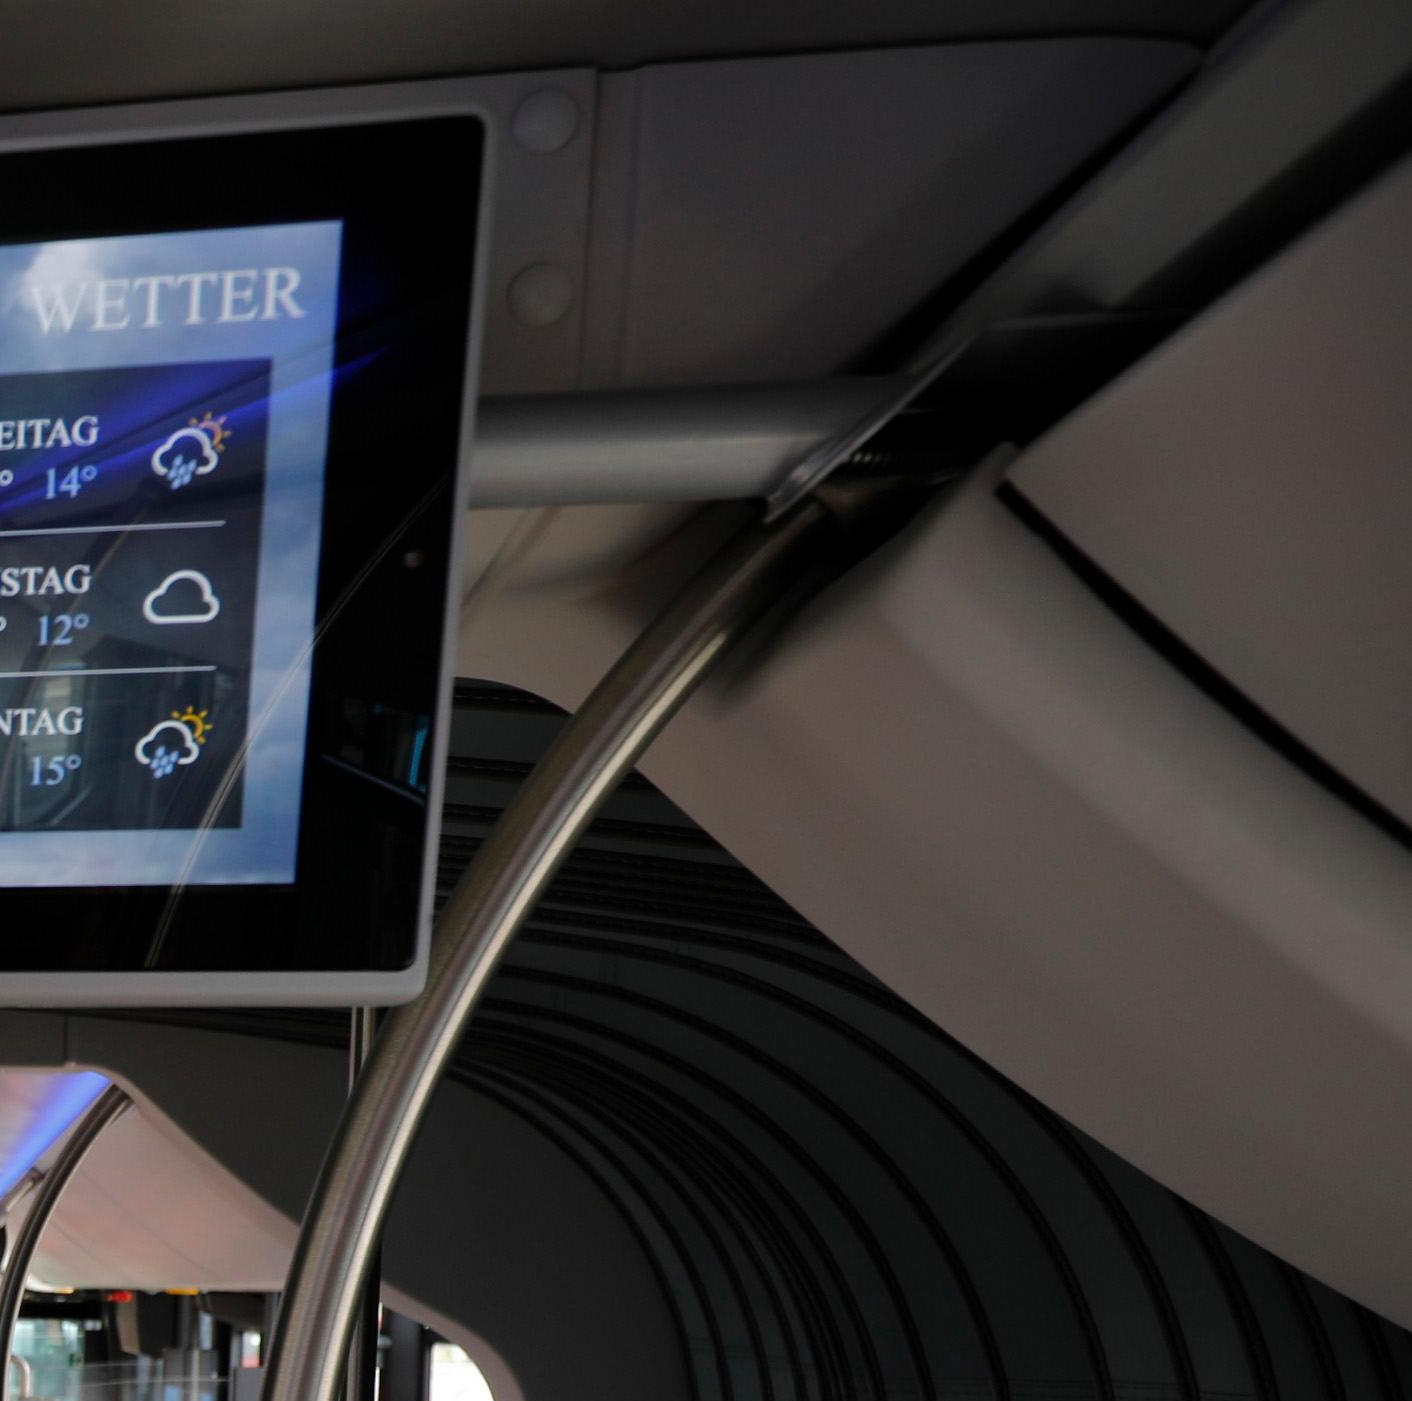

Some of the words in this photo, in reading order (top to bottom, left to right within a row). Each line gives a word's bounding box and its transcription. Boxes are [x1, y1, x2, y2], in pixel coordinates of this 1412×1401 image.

[30, 266, 308, 335] WETTER
[44, 465, 98, 501] 14°
[37, 612, 91, 647] 12°
[30, 753, 83, 787] 15°
